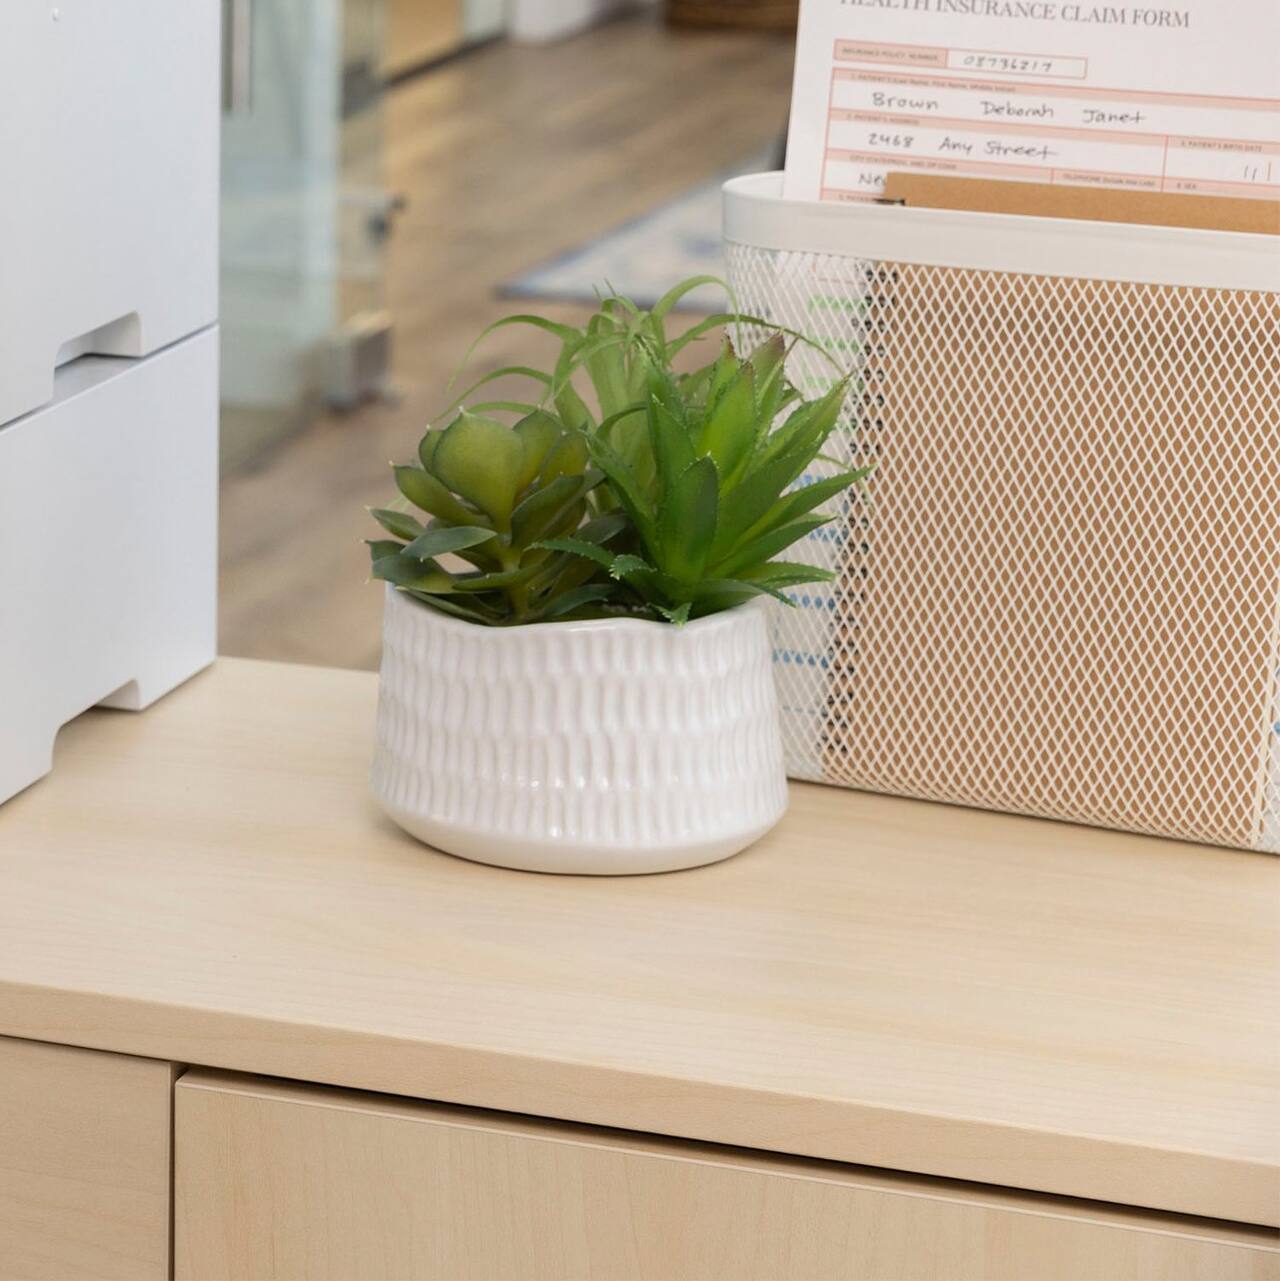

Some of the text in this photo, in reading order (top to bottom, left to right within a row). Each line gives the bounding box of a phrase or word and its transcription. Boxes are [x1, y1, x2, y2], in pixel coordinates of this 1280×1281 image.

[1061, 4, 1125, 24] CLAIM
[1132, 9, 1190, 28] FORM
[872, 91, 1146, 124] Brown Deborah Janet
[868, 132, 1058, 160] 2468 Any Street
[858, 172, 887, 186] Ne
